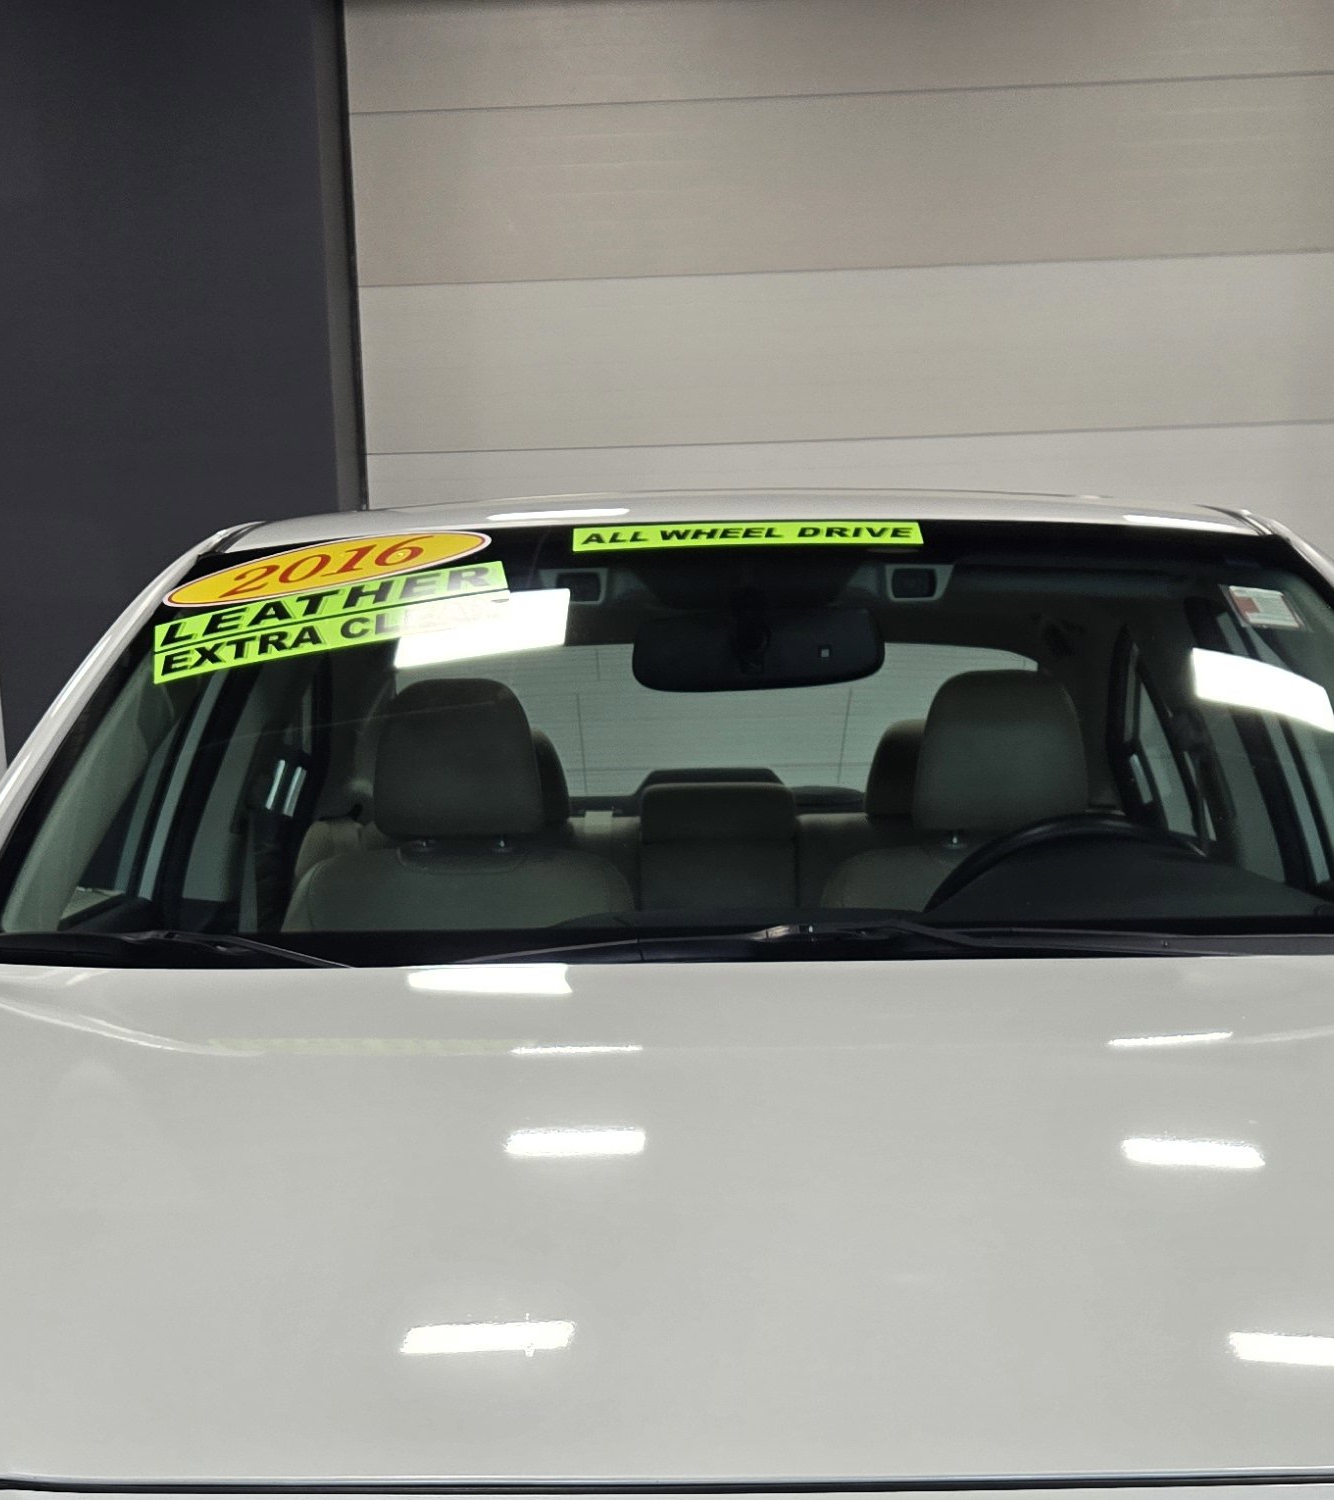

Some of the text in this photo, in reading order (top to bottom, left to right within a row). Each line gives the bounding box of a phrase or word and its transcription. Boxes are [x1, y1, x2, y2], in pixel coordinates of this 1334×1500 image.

[582, 527, 914, 545] ALL WHEEL DRIVE
[220, 535, 434, 598] 2016
[161, 566, 491, 647] LEATHER
[161, 622, 322, 676] EXTRA
